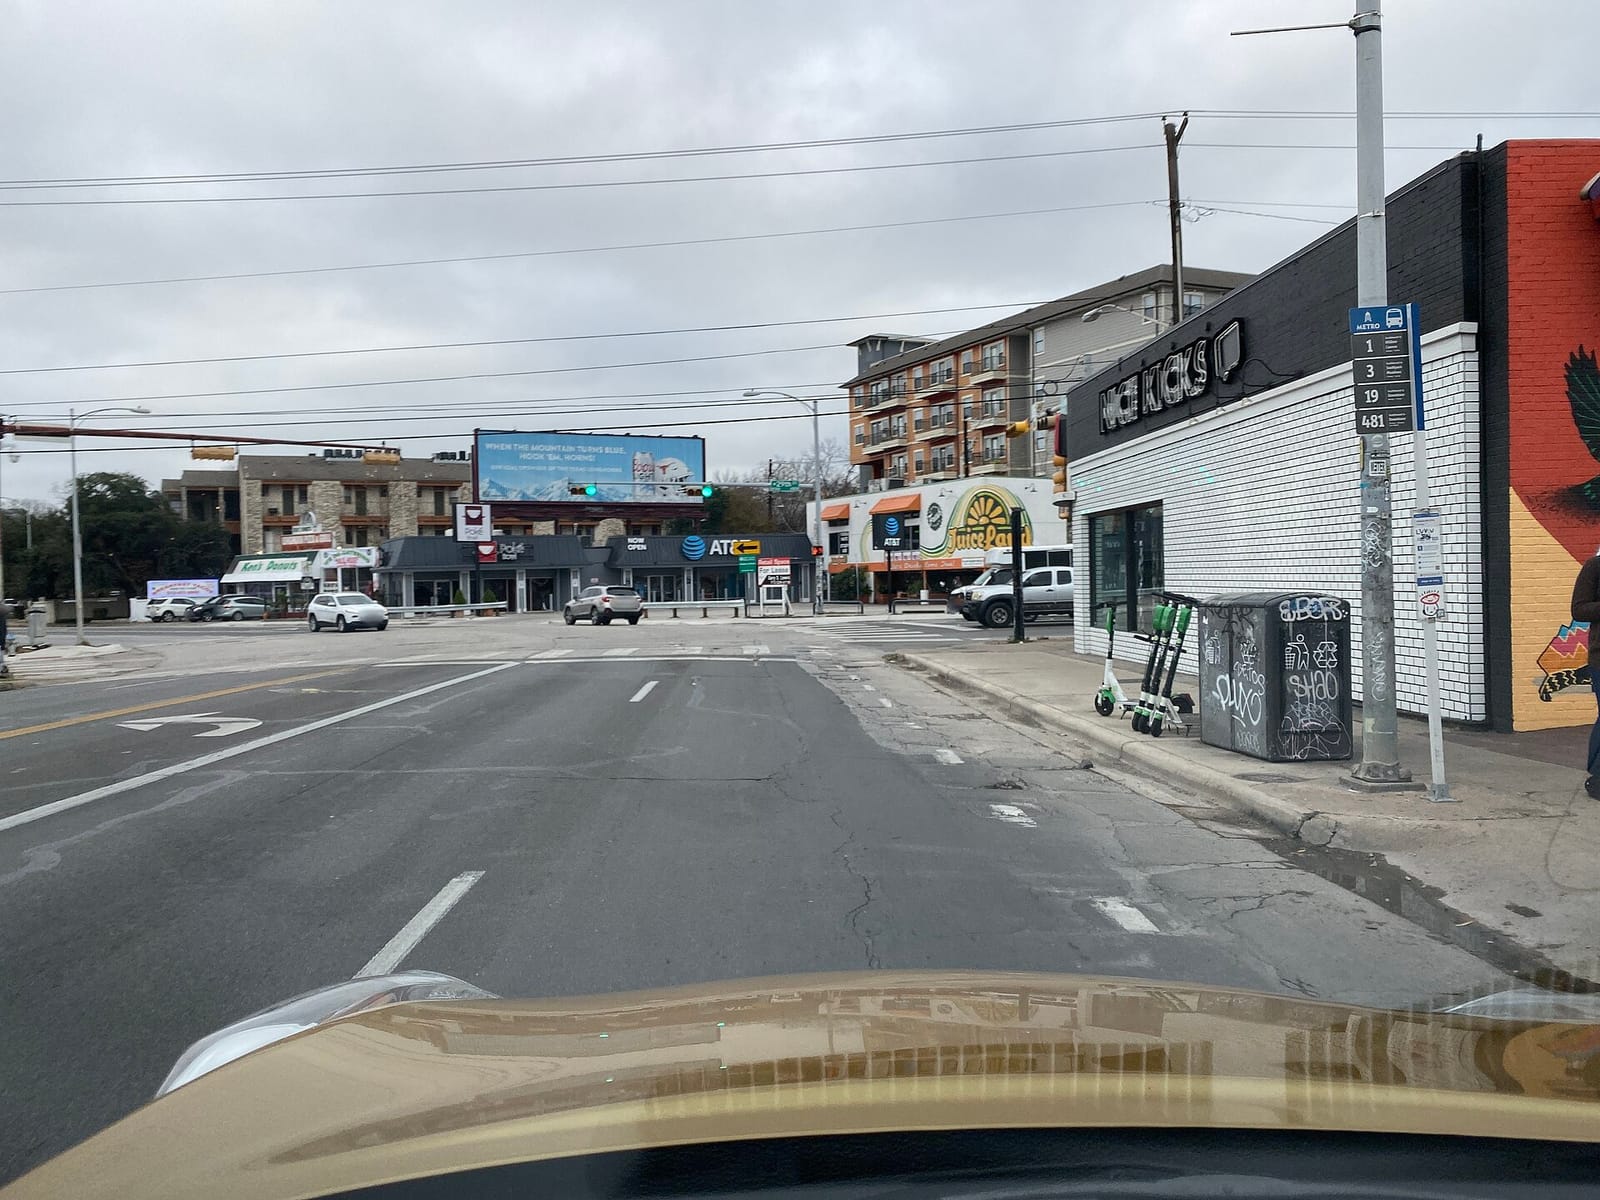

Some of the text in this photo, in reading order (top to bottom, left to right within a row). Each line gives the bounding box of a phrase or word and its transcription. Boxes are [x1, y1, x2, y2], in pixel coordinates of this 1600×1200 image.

[1366, 340, 1374, 353] 1
[1142, 340, 1208, 415] KICKS
[1366, 364, 1375, 378] 3
[1364, 389, 1379, 403] 19
[1361, 414, 1386, 429] 481
[884, 537, 901, 546] AT&T
[241, 560, 298, 572] Ken's Donuts
